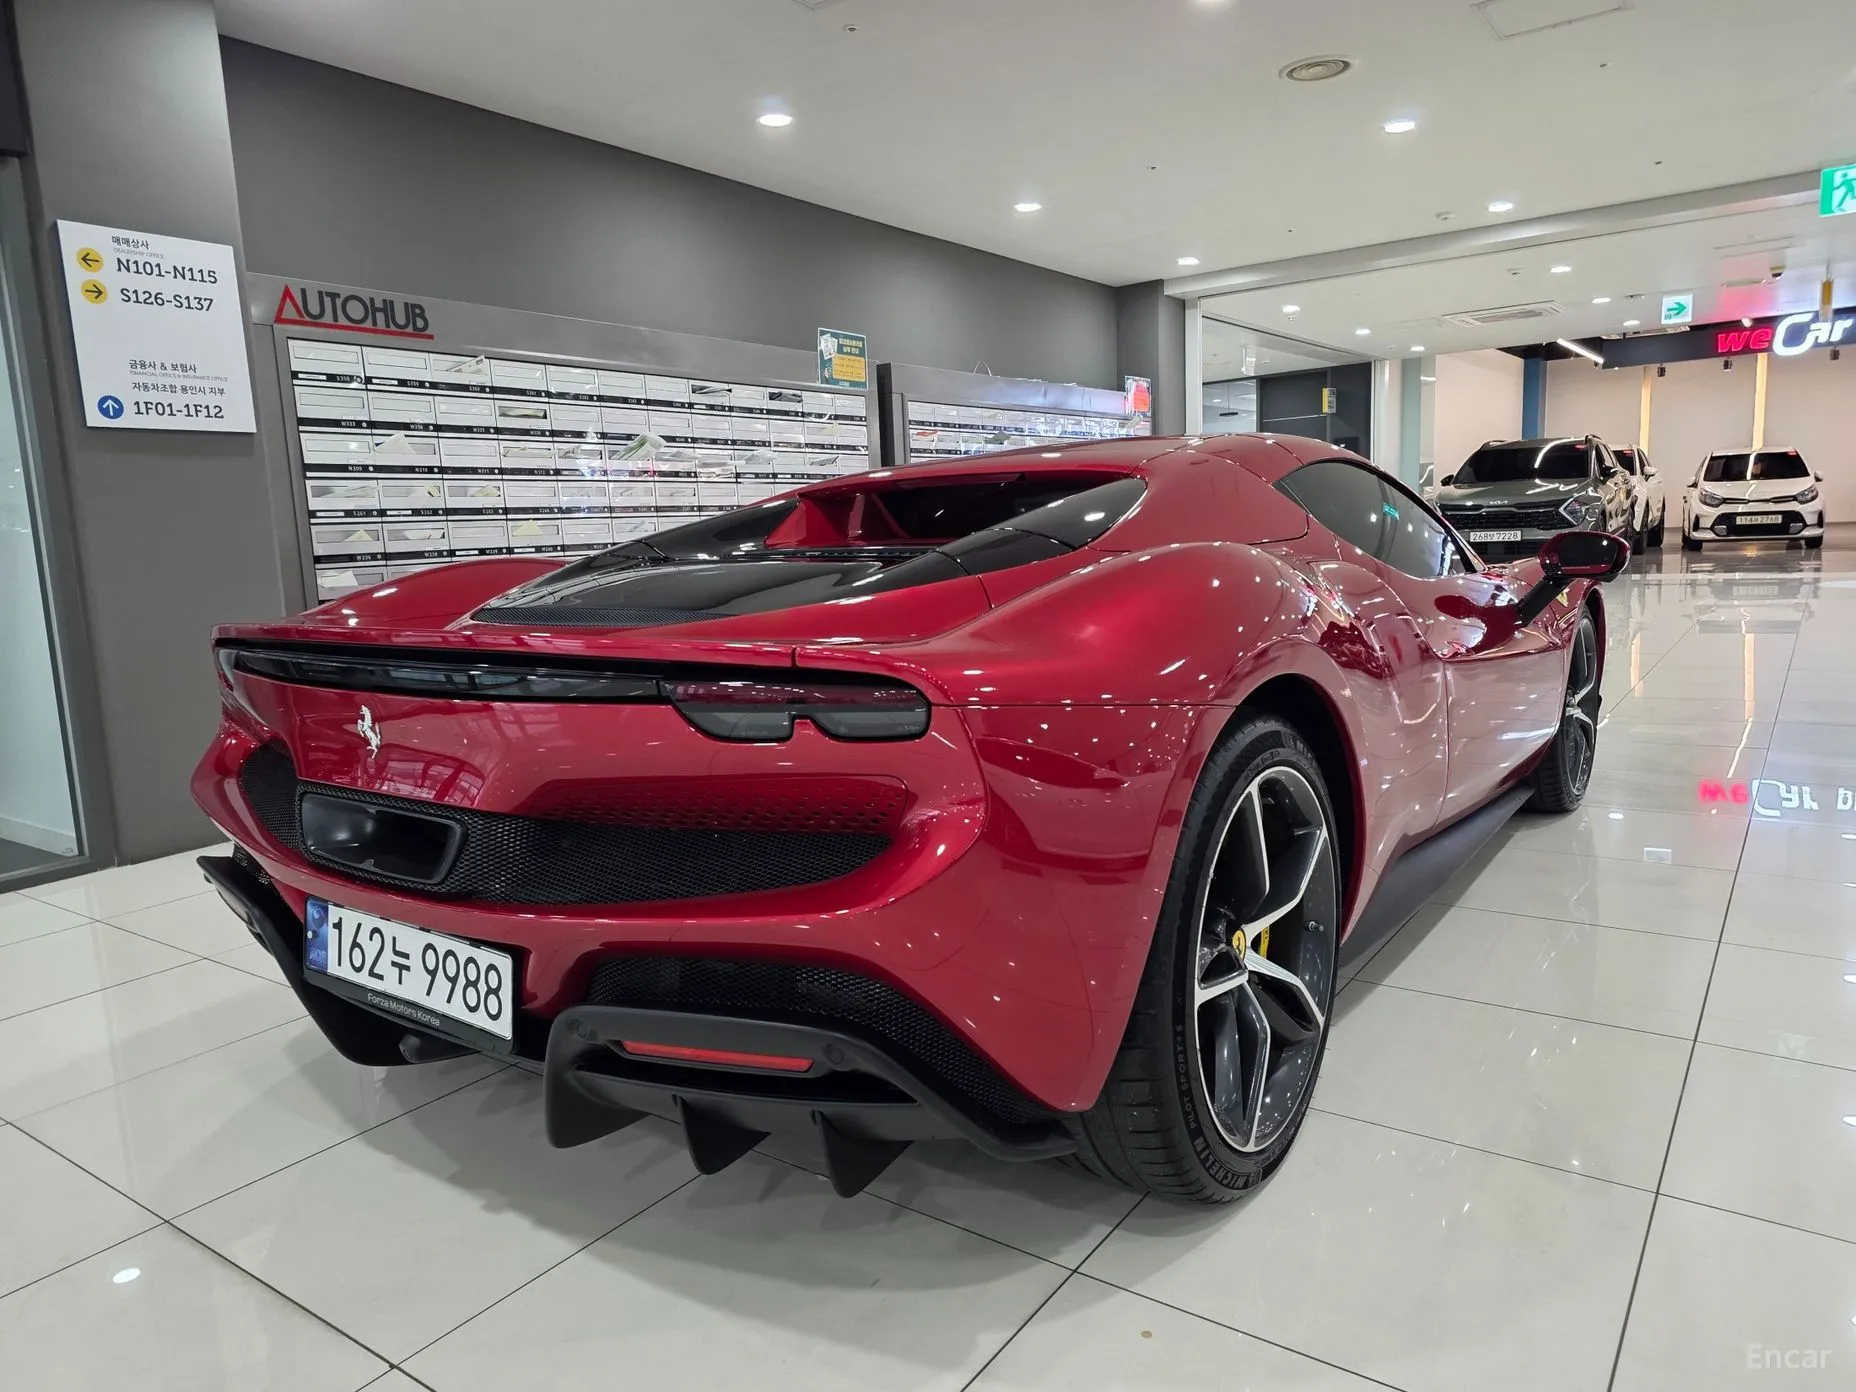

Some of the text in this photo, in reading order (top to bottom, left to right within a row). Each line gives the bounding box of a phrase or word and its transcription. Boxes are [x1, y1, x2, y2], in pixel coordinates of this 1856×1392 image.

[112, 235, 149, 250] 매매상사
[116, 257, 218, 284] N101-N115
[120, 288, 214, 311] S126-S137
[274, 284, 432, 335] AUTOHUB
[129, 359, 197, 374] 금융사 & 보험사
[132, 382, 178, 394] 자동차조합
[208, 387, 226, 396] 지부
[133, 401, 225, 419] 1F01-1F12
[367, 992, 440, 1027] Forza Motors Korea
[1183, 1096, 1196, 1130] PILOT
[1193, 1135, 1245, 1190] MICHELIN
